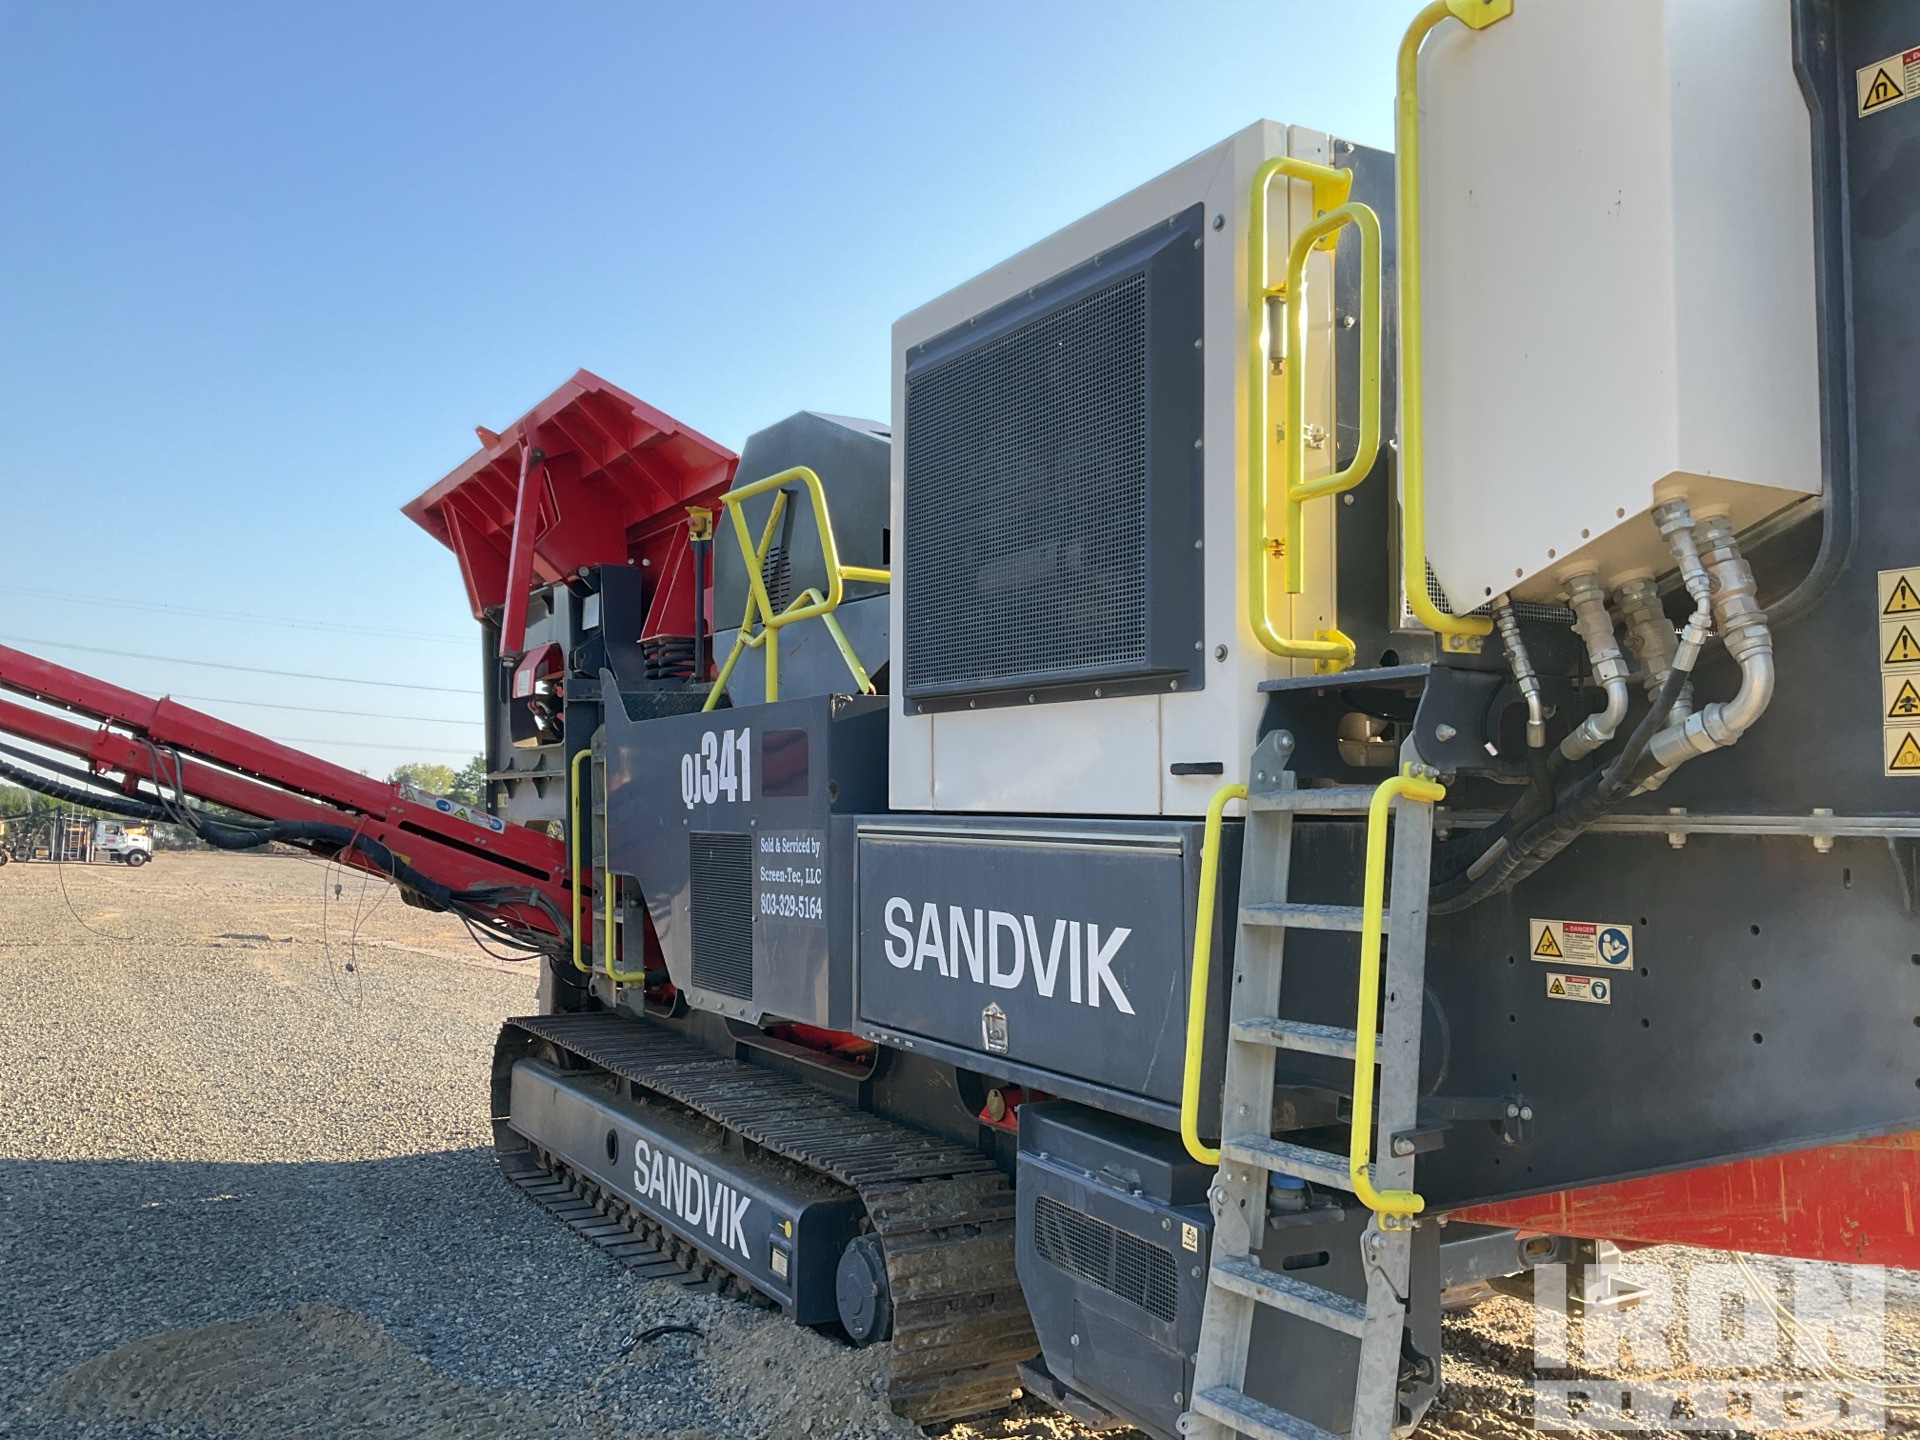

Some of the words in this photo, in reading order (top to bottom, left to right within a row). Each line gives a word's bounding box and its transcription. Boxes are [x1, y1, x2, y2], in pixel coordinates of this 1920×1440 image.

[681, 727, 751, 809] QJ341
[760, 837, 774, 853] Sold
[775, 837, 781, 852] &
[782, 837, 810, 853] Serviced
[811, 837, 820, 858] by
[760, 866, 804, 886] Screen-Tec,
[805, 868, 822, 885] LLC
[760, 892, 822, 920] 803-329-5164
[1569, 925, 1595, 933] DANGER
[884, 896, 1136, 1015] SANDVIK
[633, 1139, 751, 1260] SANDVIK
